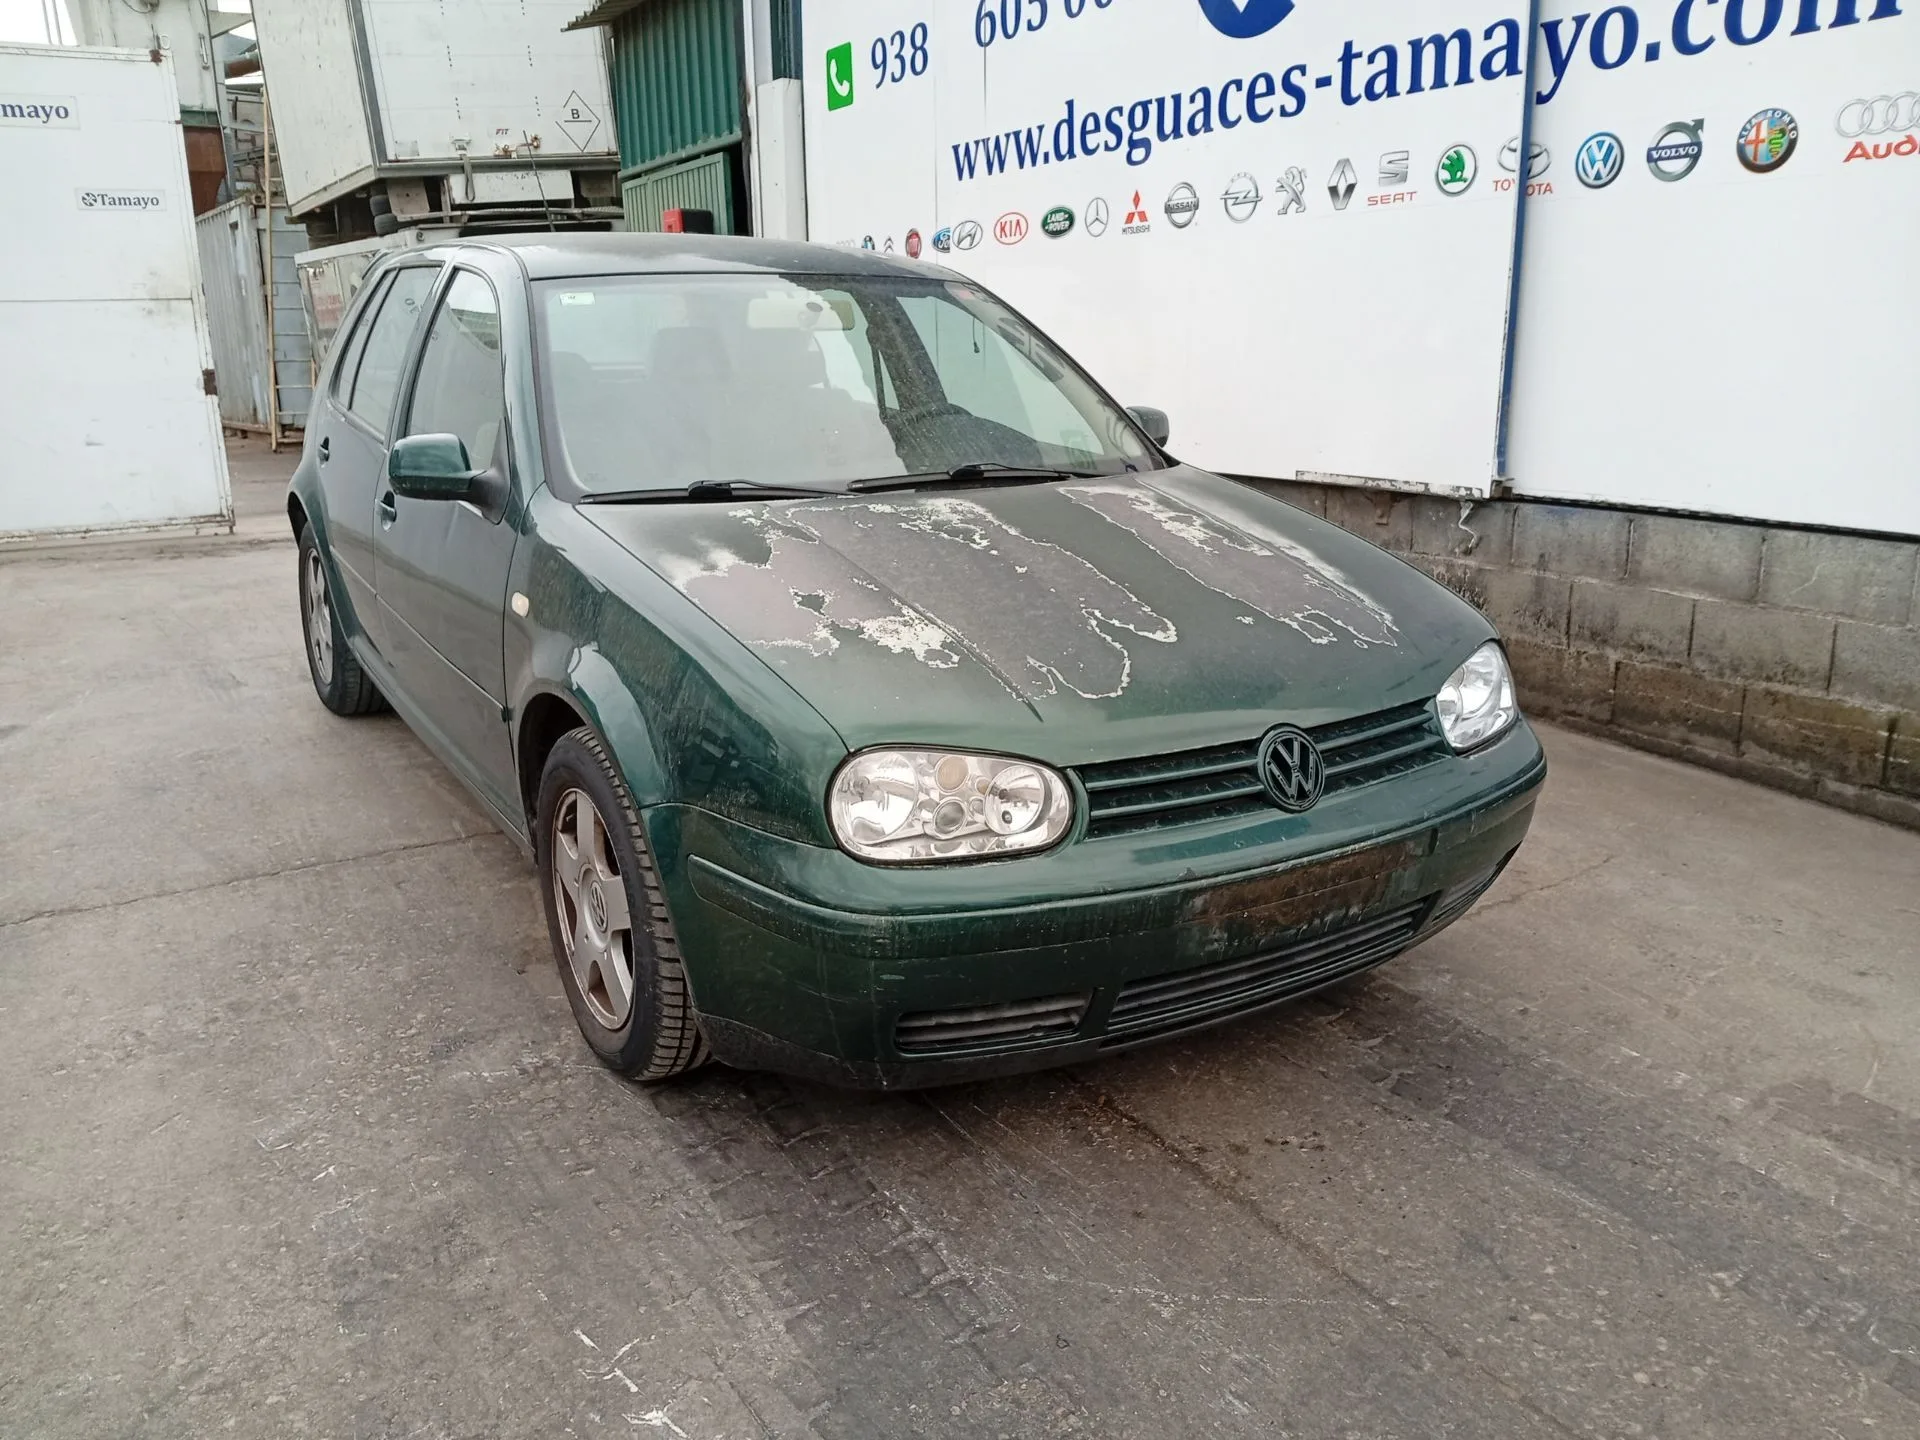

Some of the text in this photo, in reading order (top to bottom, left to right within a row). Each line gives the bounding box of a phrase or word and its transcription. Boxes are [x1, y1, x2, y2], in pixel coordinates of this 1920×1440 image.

[871, 22, 928, 89] 938
[571, 109, 580, 119] B
[1651, 145, 1698, 159] VOLVO
[1842, 134, 1920, 162] Aud
[97, 193, 160, 209] Tamayo
[1167, 200, 1197, 211] NISSAN
[1367, 191, 1418, 206] SEAT
[1000, 218, 1022, 239] KIA
